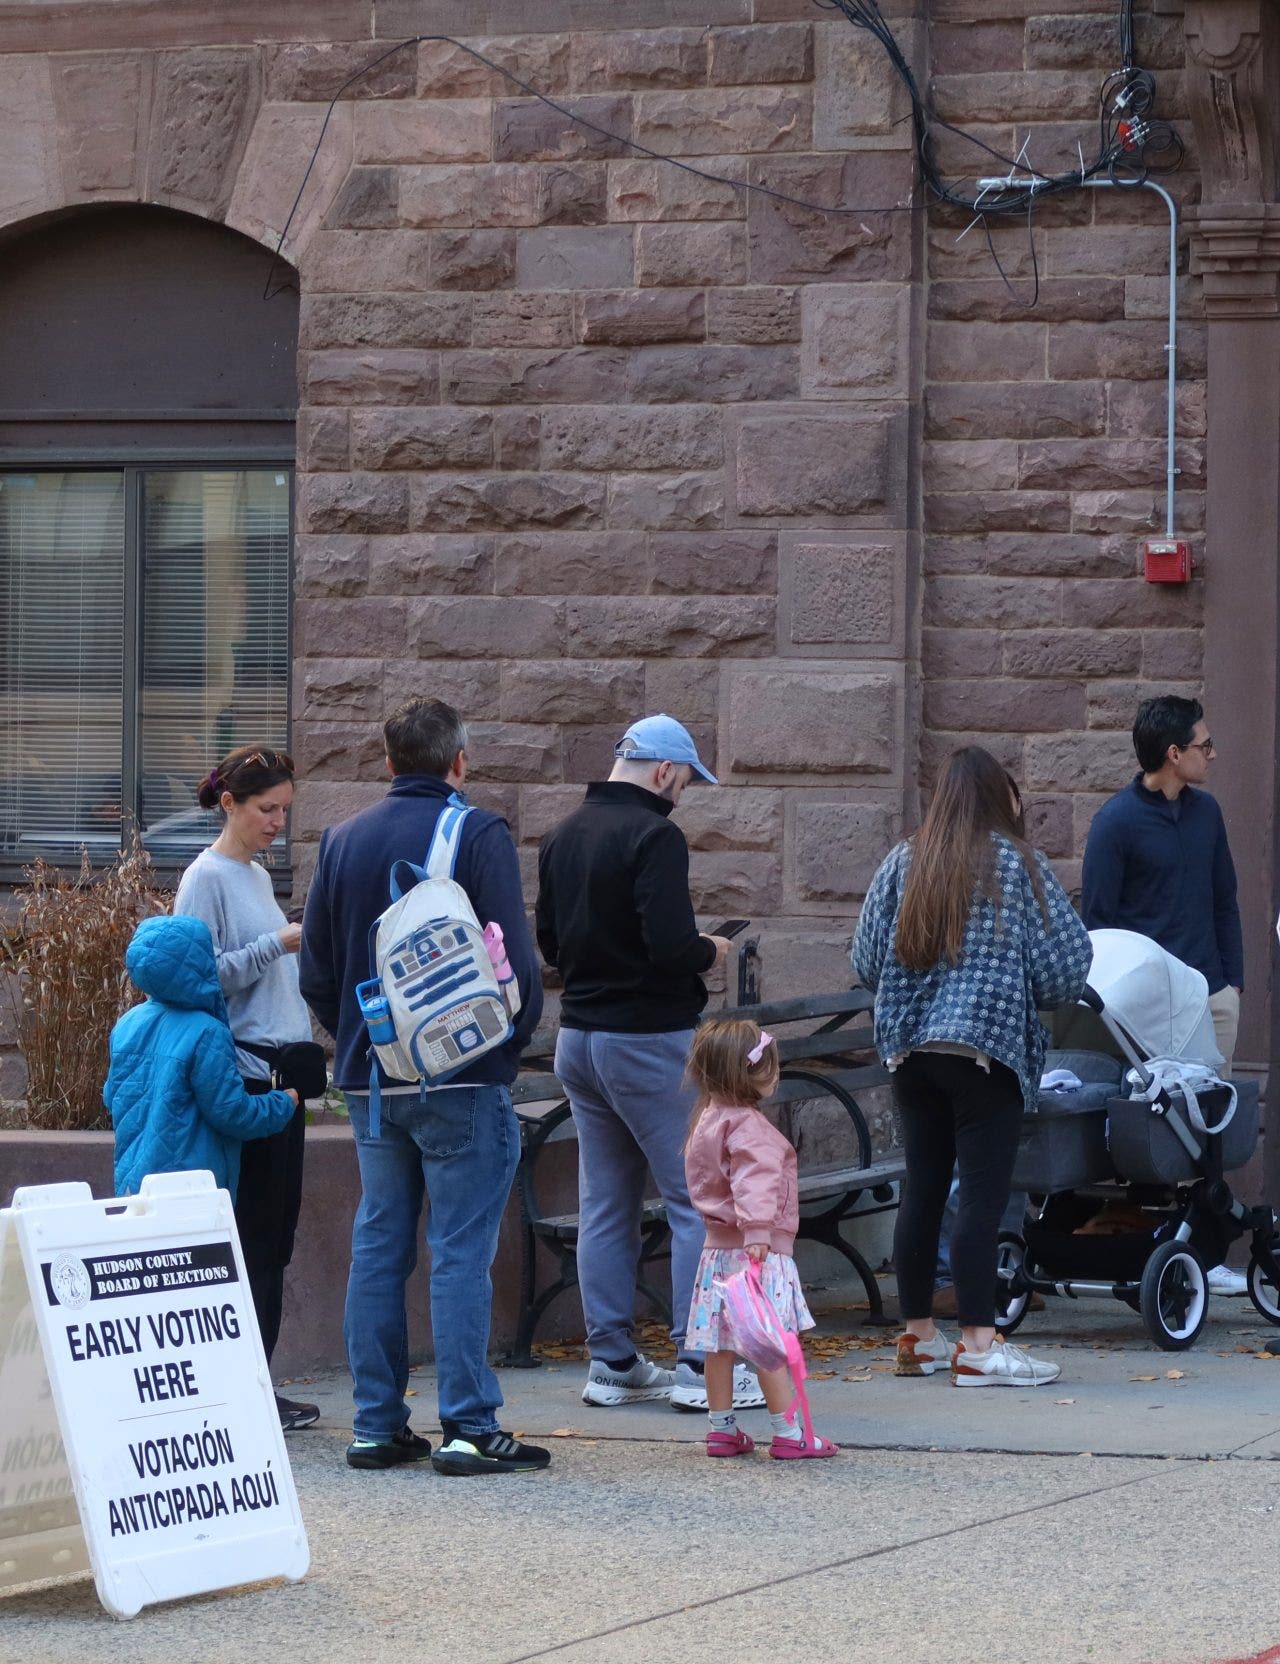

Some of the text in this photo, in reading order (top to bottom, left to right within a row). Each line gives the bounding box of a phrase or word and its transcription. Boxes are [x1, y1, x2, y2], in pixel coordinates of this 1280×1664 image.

[437, 1002, 471, 1024] MATTHEW
[92, 1251, 193, 1276] HUDSON COUNTY
[97, 1266, 229, 1295] BOARD OF ELECTIONS
[66, 1316, 142, 1362] EARLY
[147, 1303, 241, 1349] VOTING
[133, 1360, 199, 1403] HERE
[594, 1376, 611, 1386] ON
[128, 1420, 235, 1479] VOTACIÓN
[108, 1481, 230, 1537] ANTICIPADA
[231, 1460, 279, 1514] AQUÍ
